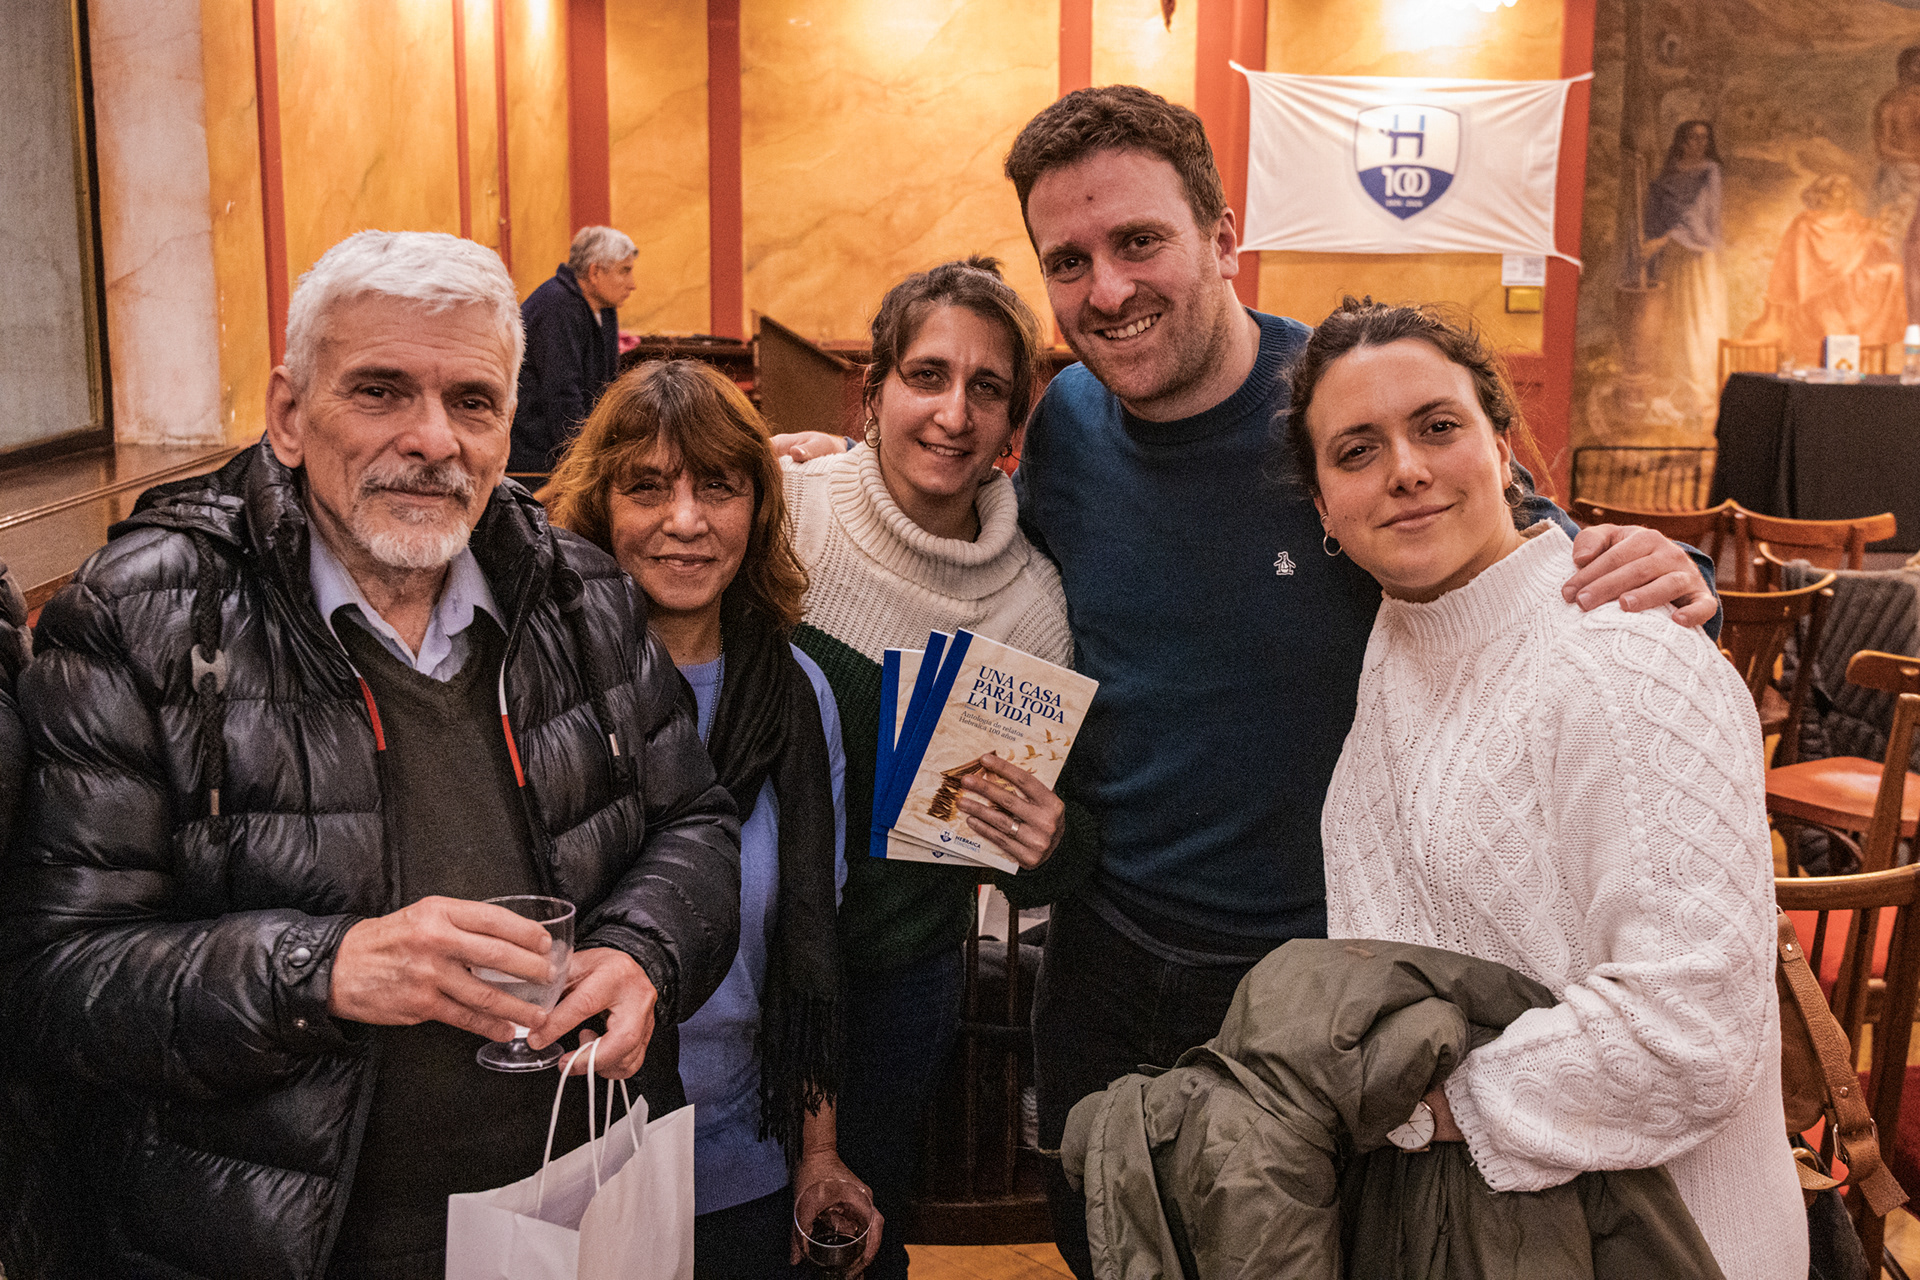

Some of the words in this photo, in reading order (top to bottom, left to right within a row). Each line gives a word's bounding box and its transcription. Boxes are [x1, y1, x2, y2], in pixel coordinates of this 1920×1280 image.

[1381, 166, 1431, 198] 100
[972, 678, 1014, 705] PARA
[1020, 695, 1064, 724] TODA
[979, 665, 1014, 690] UNA
[1019, 681, 1061, 707] CASA
[967, 692, 987, 710] LA
[994, 700, 1031, 727] VIDA
[958, 716, 987, 731] Hebraica
[988, 727, 1001, 736] 100
[1000, 732, 1017, 742] años
[992, 721, 1002, 729] de
[1002, 726, 1024, 738] relatos
[955, 835, 981, 849] HEBRAICA
